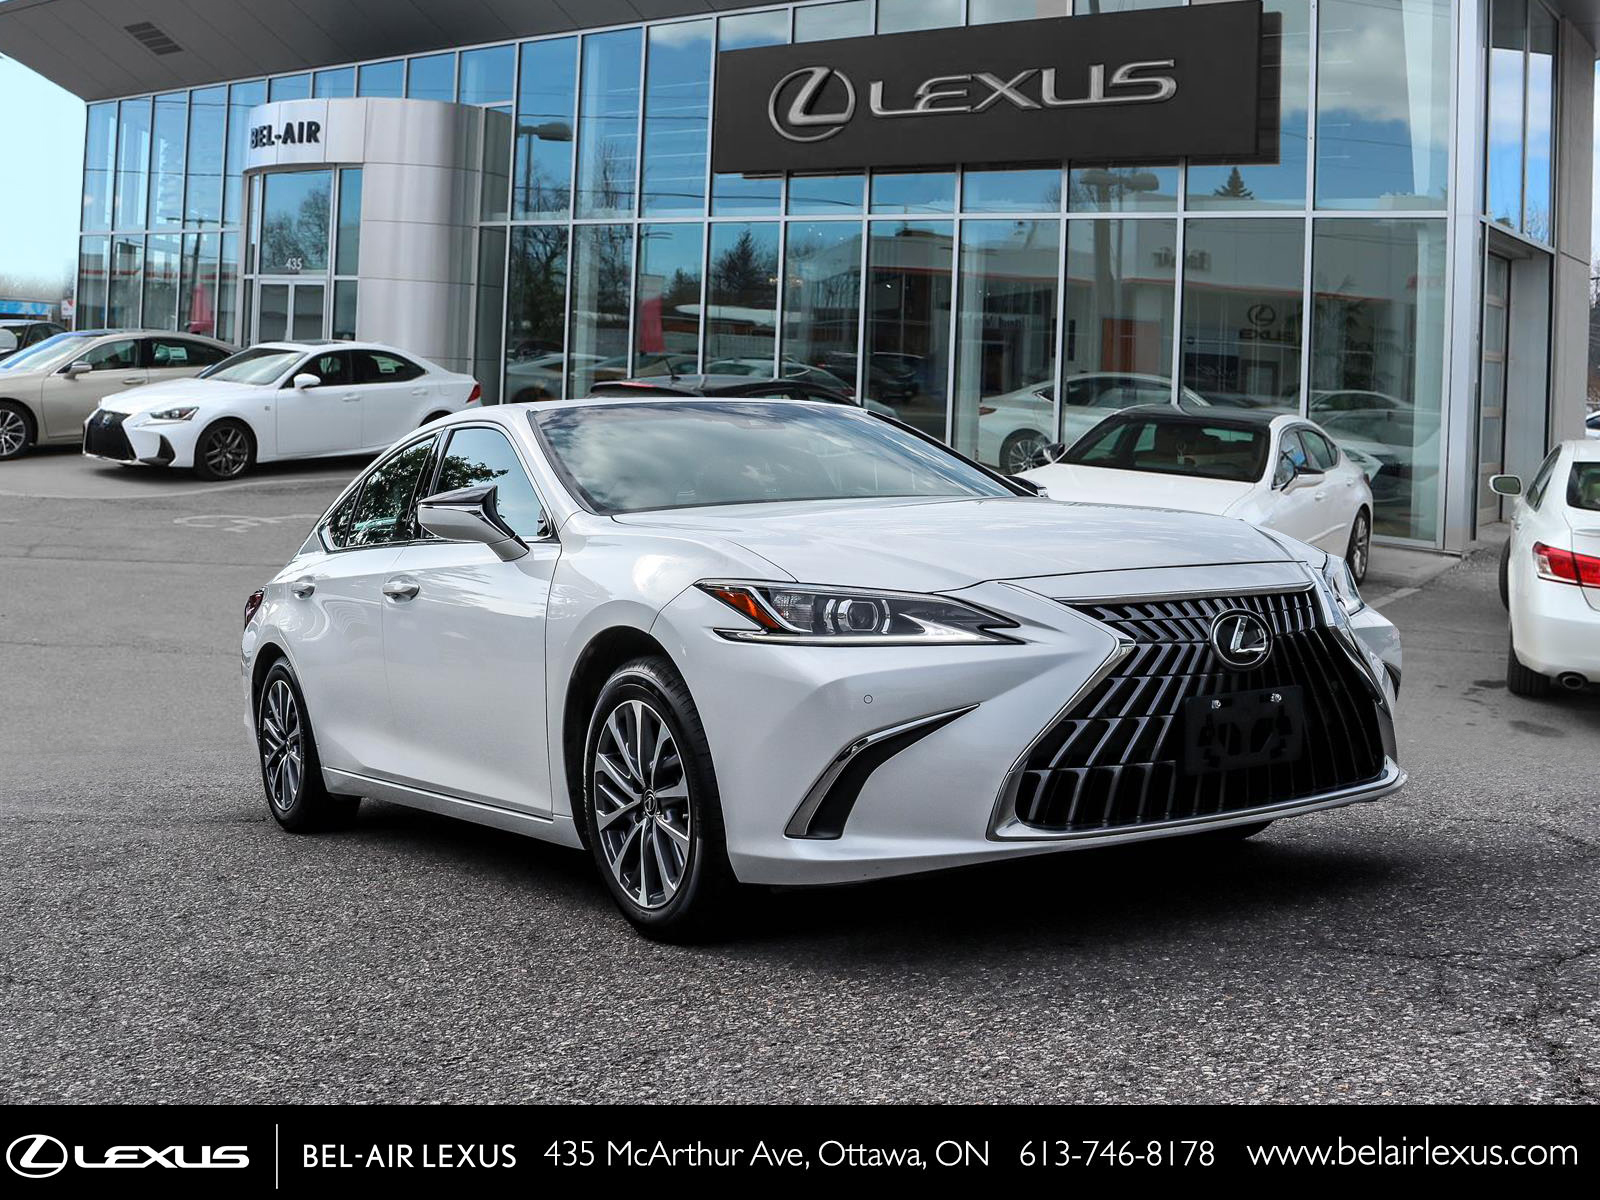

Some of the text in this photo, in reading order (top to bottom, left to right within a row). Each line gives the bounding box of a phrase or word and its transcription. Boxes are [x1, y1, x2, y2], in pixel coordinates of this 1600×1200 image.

[868, 58, 1178, 118] LEXUS
[250, 120, 322, 149] BEL-AIR
[285, 257, 303, 271] 435
